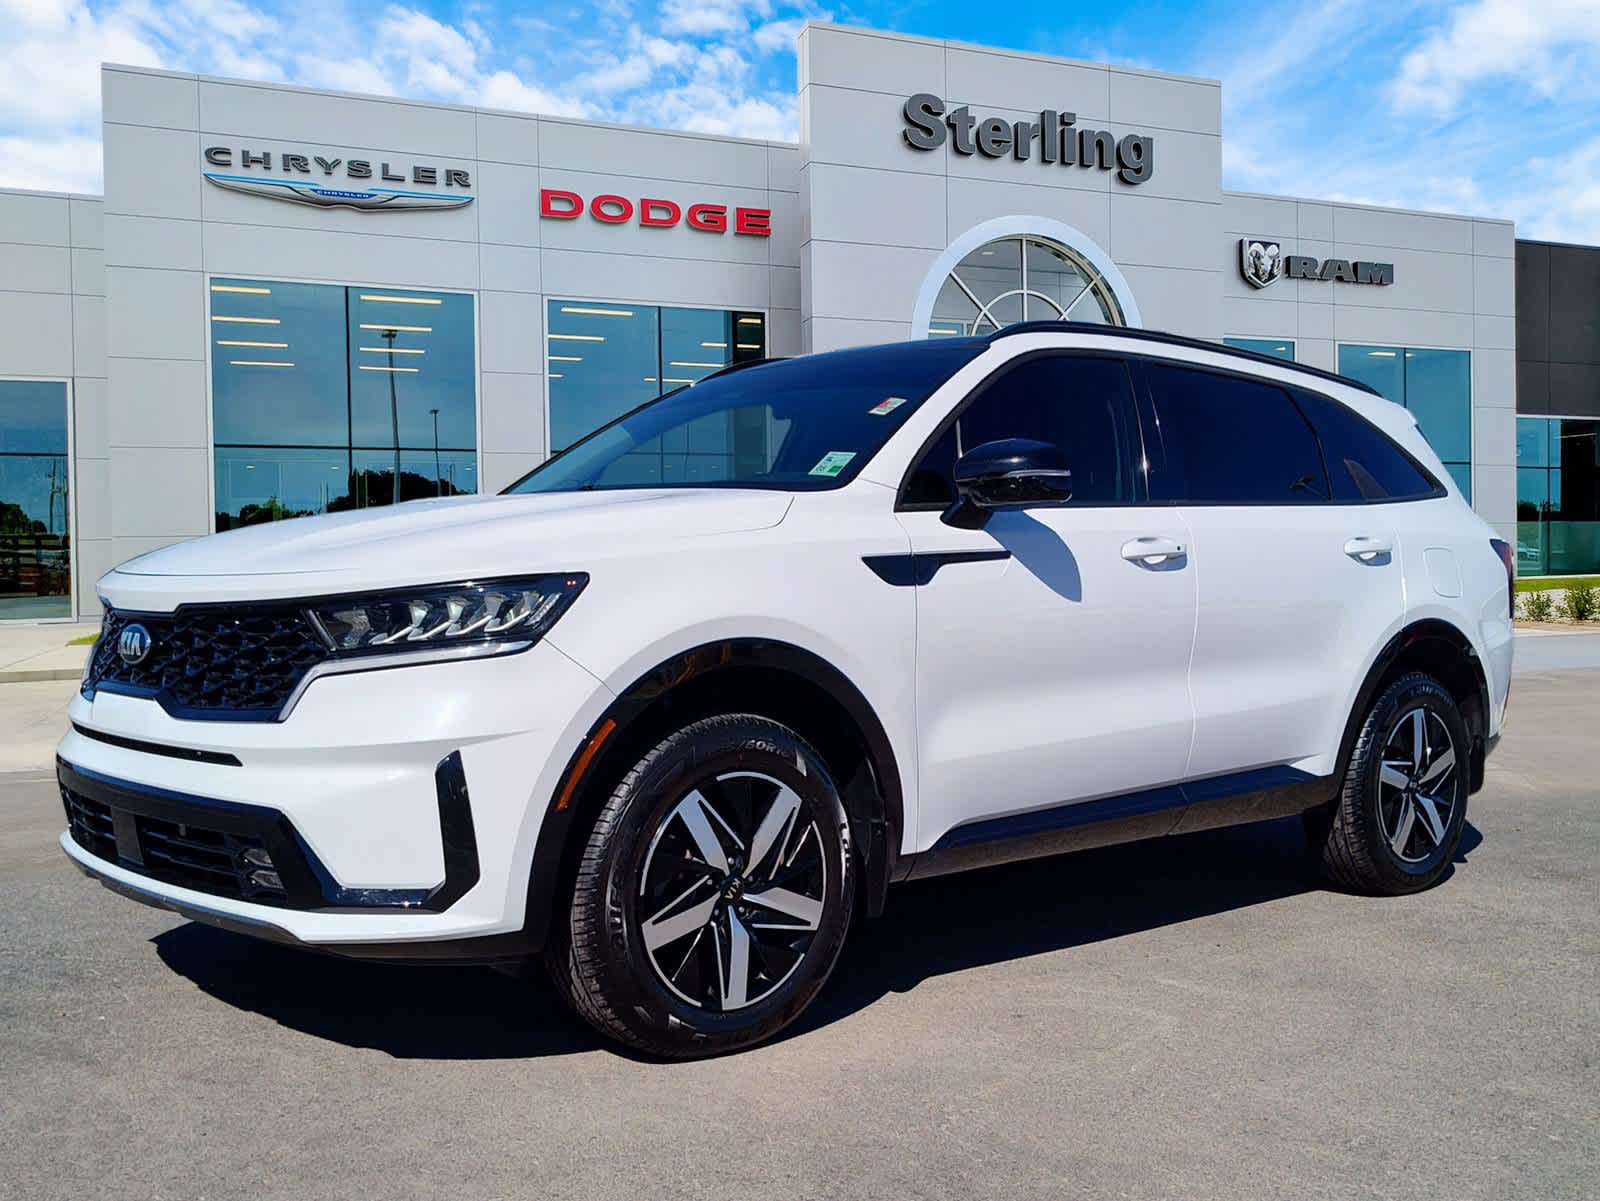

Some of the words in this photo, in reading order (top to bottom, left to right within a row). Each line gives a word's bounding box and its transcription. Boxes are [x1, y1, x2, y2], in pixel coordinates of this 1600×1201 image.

[903, 93, 1154, 184] Sterling
[204, 146, 472, 188] CHRYSLER
[540, 188, 771, 237] DODGE
[1285, 255, 1394, 286] RAM
[119, 631, 141, 656] KIA
